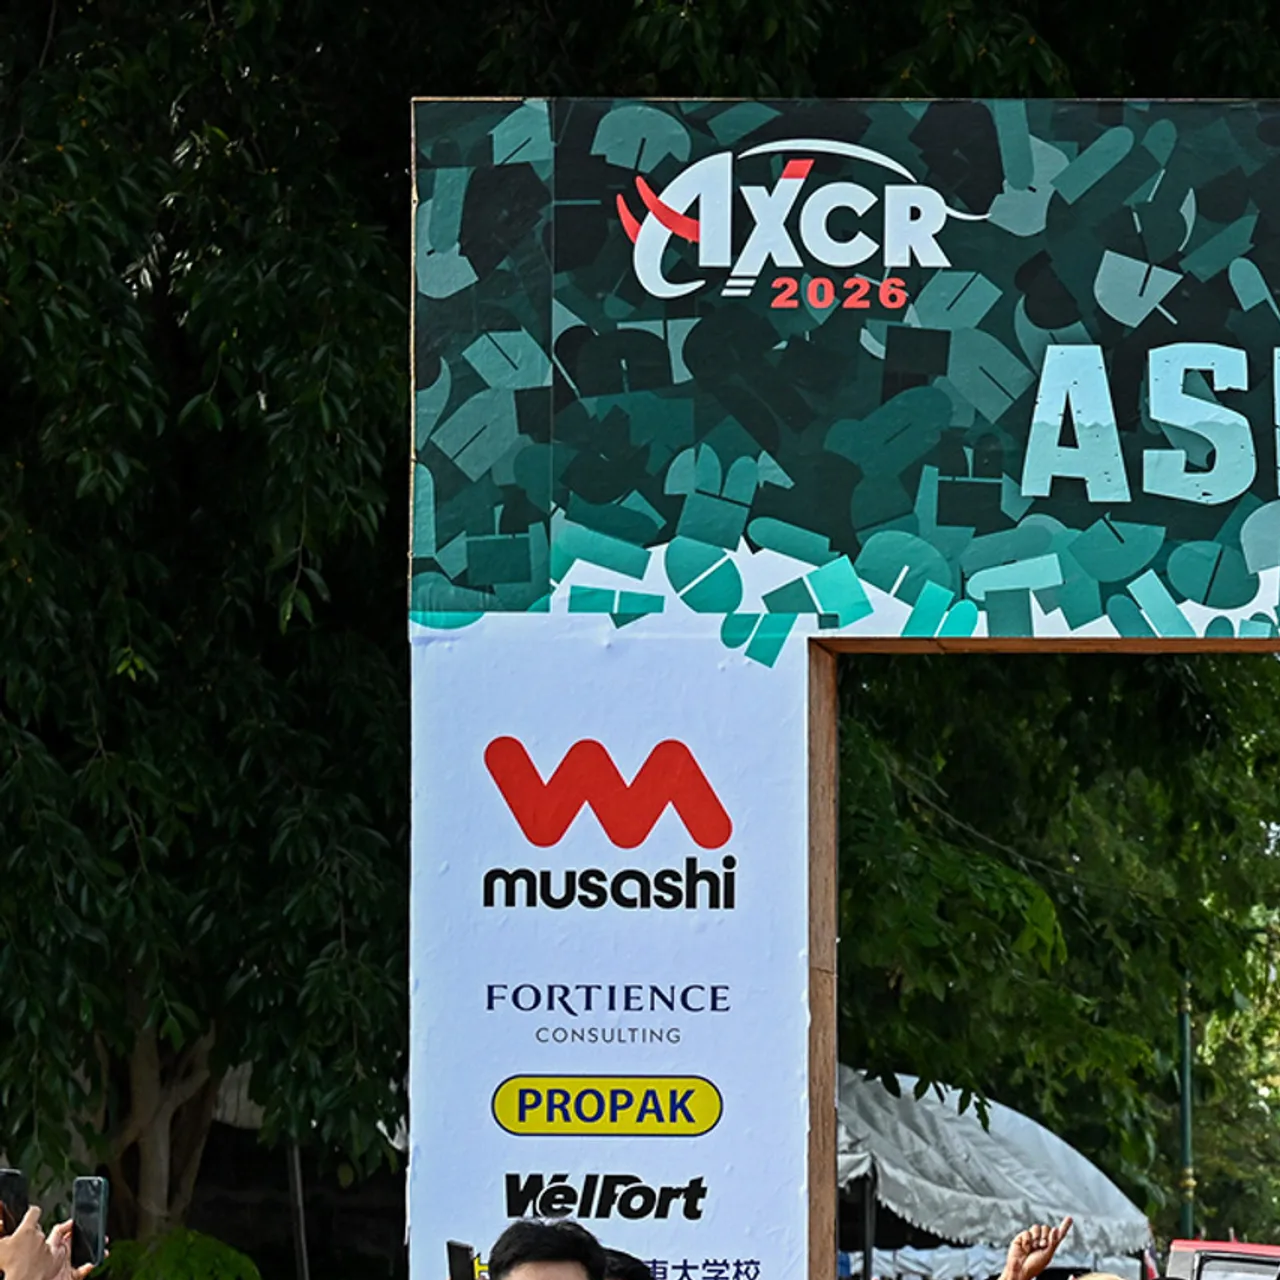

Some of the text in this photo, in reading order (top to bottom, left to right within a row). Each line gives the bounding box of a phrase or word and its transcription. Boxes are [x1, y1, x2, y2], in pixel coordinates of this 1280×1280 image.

[618, 146, 962, 298] AXCR
[770, 276, 907, 309] 2026
[483, 855, 737, 909] musashi
[486, 984, 731, 1016] FORTIENCE
[535, 1027, 681, 1044] CONSULTING
[518, 1089, 696, 1123] PROPAK
